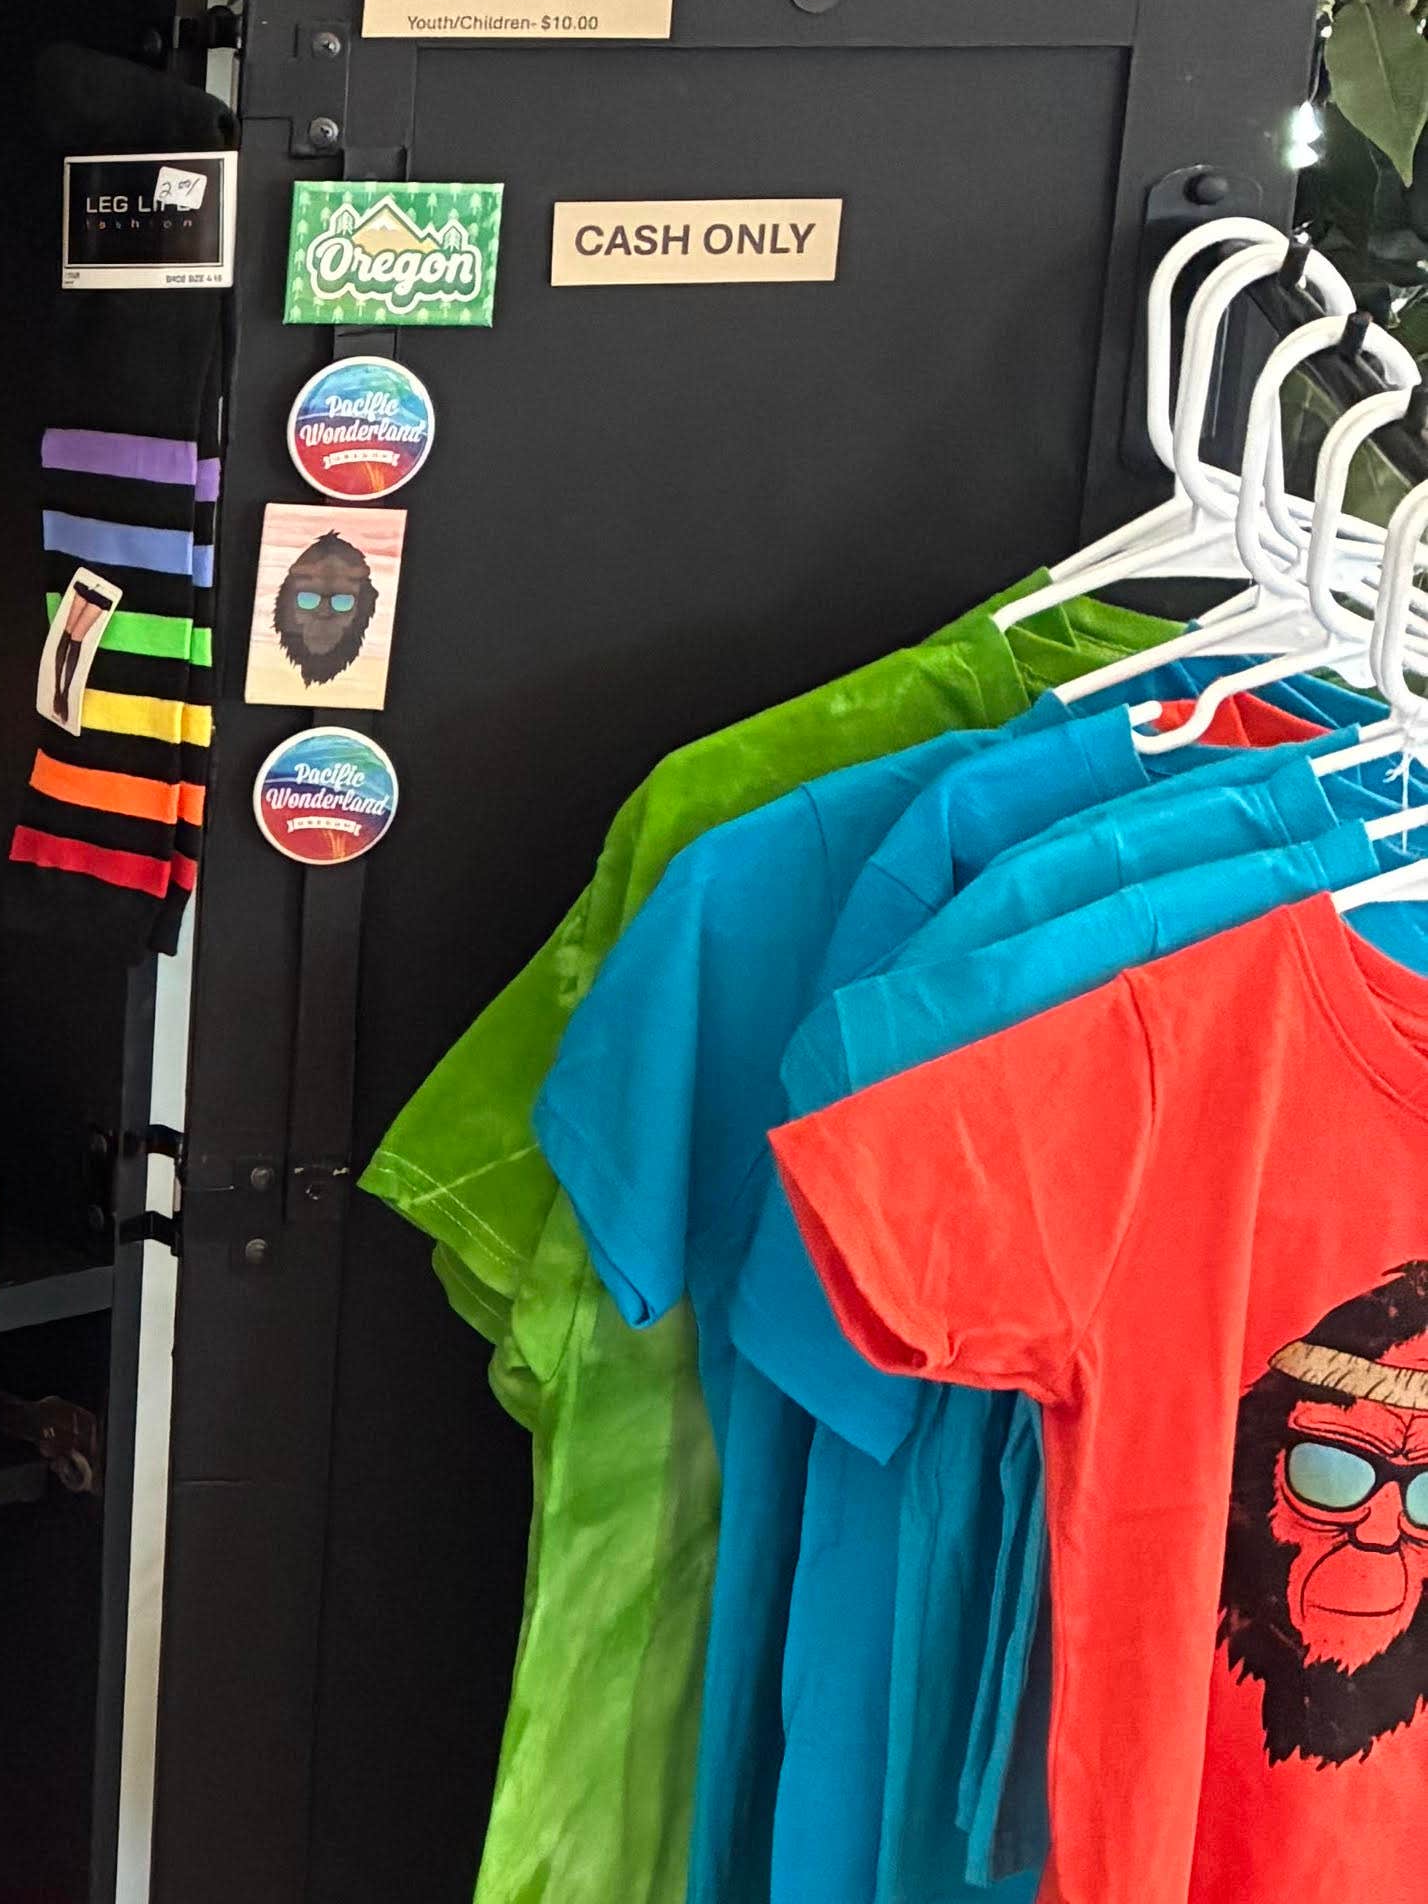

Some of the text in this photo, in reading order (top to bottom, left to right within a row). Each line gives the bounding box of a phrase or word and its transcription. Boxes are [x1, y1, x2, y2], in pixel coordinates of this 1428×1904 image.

[407, 14, 599, 31] Youth/Children- $10.00
[86, 195, 129, 214] LEG
[574, 222, 818, 257] CASH ONLY
[315, 238, 475, 297] Oregon
[325, 391, 401, 421] Pacific
[299, 417, 429, 448] Wonderland
[294, 761, 366, 793] Pacific
[265, 782, 389, 816] Wonderland
